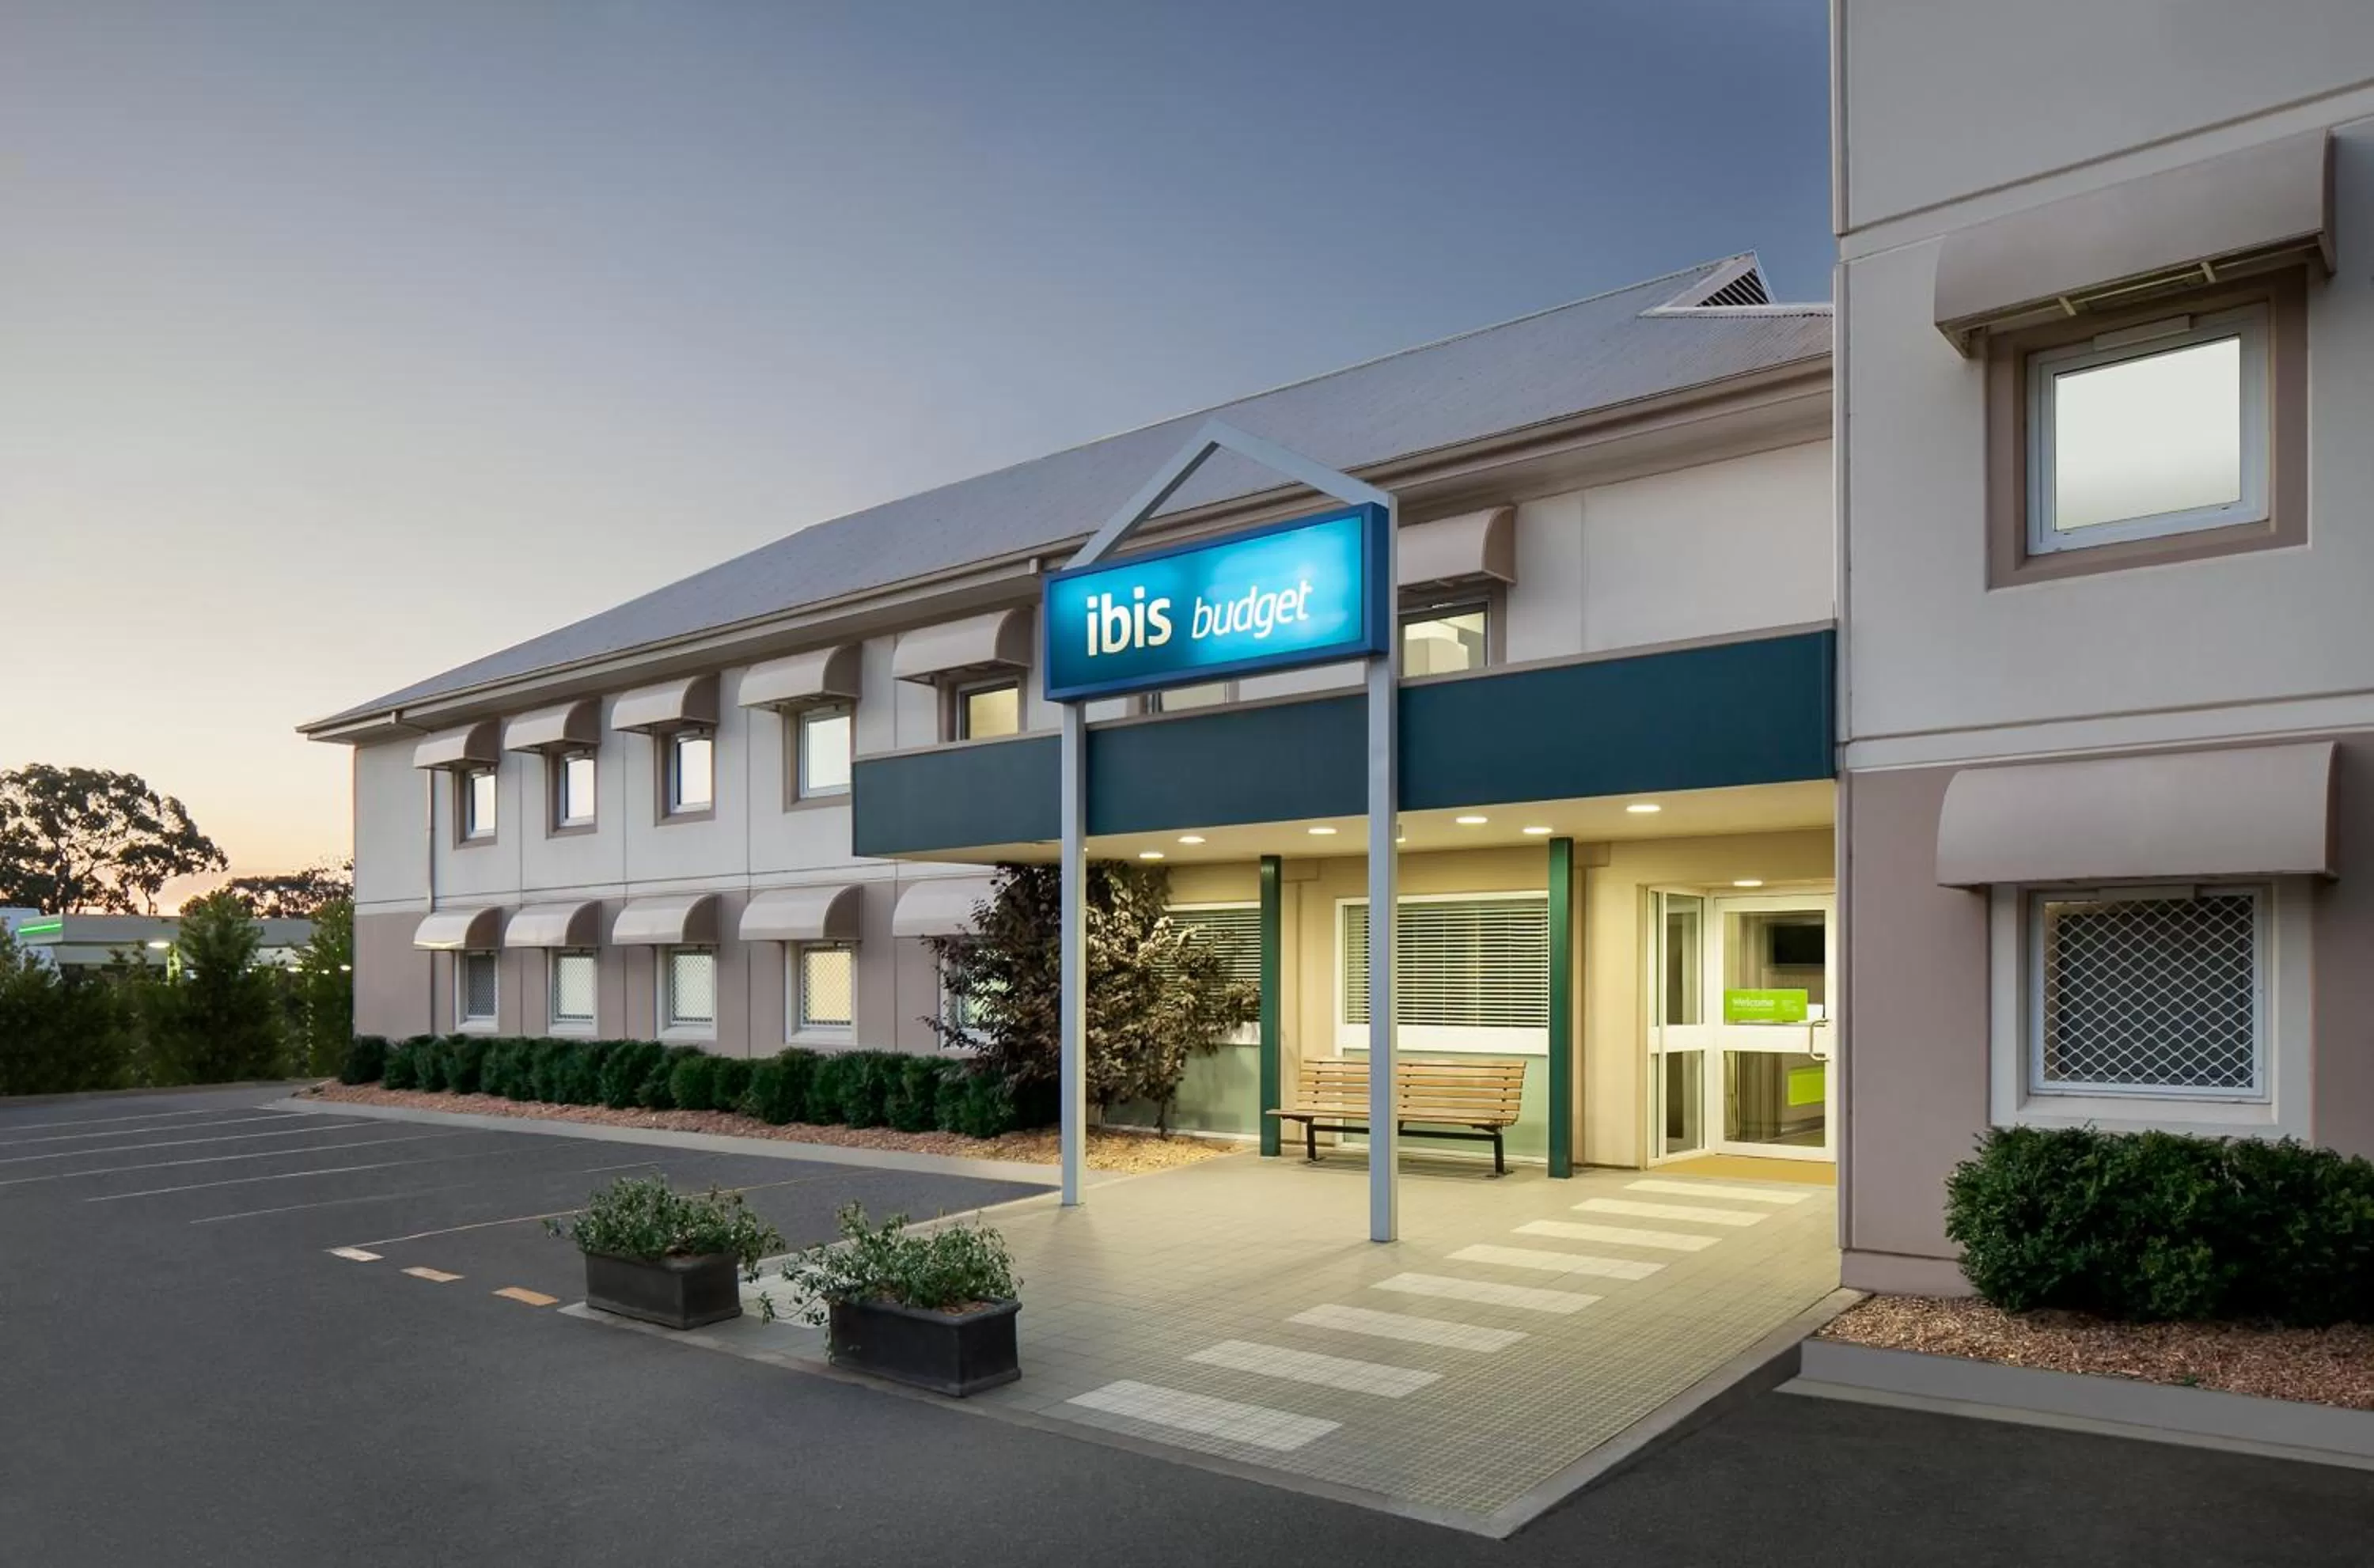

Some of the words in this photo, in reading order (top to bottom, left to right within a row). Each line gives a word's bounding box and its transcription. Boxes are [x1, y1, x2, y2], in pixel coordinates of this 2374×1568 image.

[1086, 585, 1172, 657] ibis
[1191, 579, 1314, 639] budget
[1731, 997, 1774, 1007] Welcome
